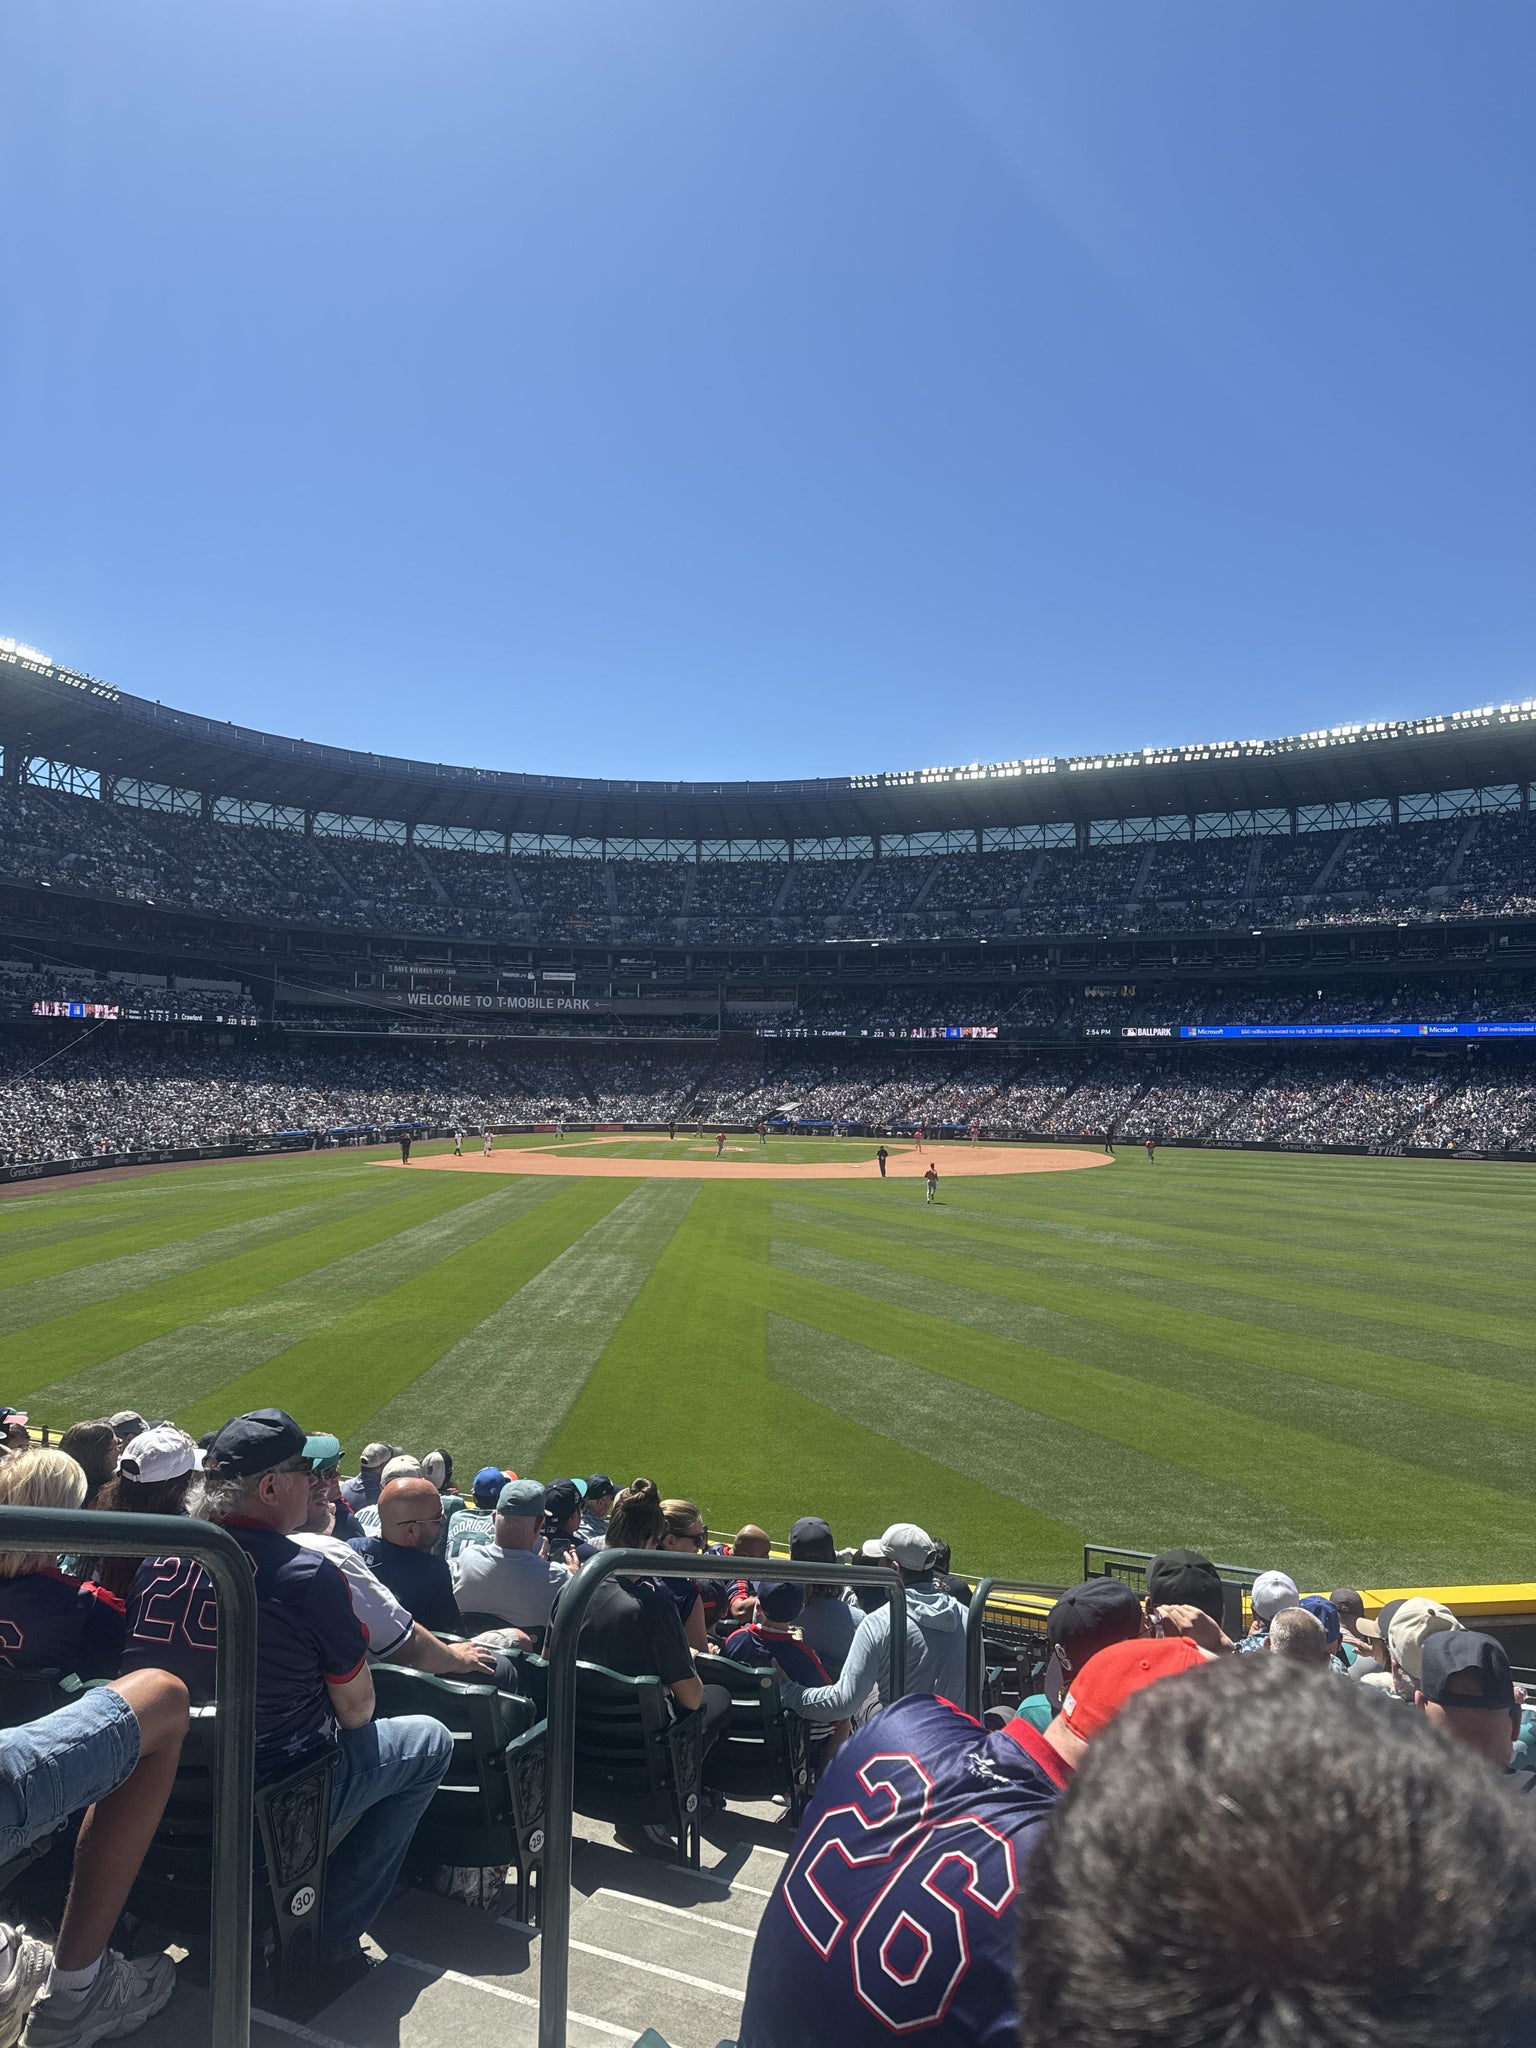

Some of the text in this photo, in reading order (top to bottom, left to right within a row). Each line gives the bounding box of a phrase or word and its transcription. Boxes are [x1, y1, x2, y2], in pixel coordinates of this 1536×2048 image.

[408, 993, 590, 1010] WELCOME TO T-MOBILE PARK
[181, 1013, 203, 1021] Crawford
[1137, 1028, 1171, 1036] BALLPARK
[1280, 1143, 1323, 1152] Great Clips
[1367, 1146, 1407, 1156] STIHL
[77, 1160, 98, 1168] LEXUS
[10, 1165, 43, 1177] Great Clips
[531, 1834, 541, 1848] 29
[781, 1752, 1019, 2036] 26
[295, 1892, 310, 1911] 30
